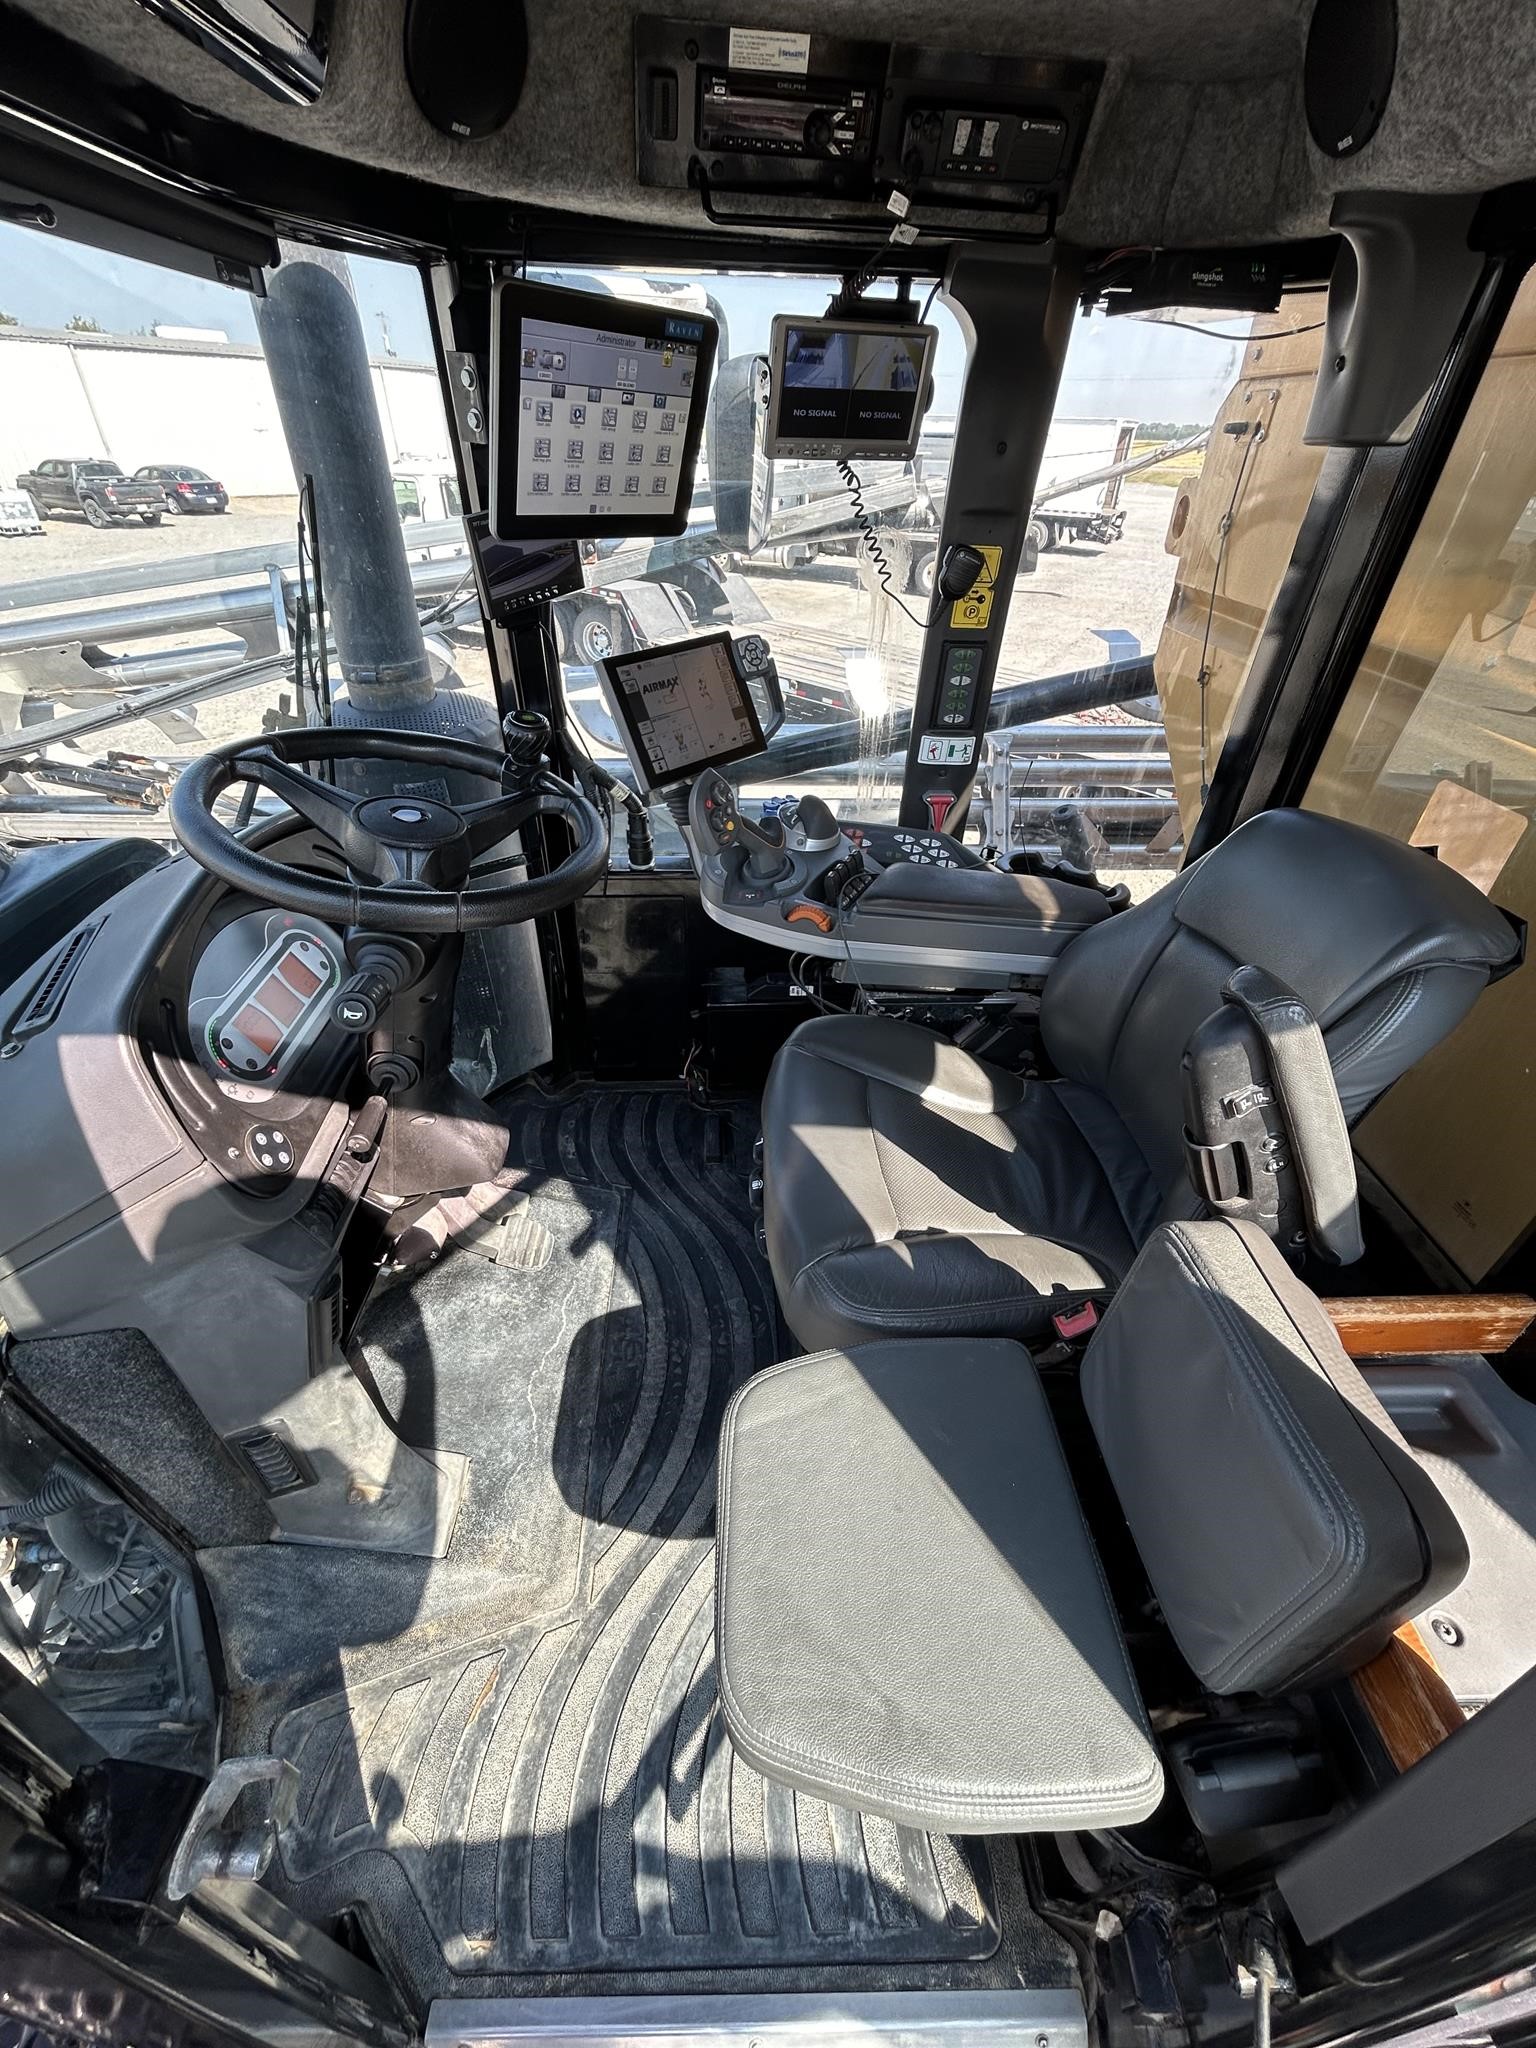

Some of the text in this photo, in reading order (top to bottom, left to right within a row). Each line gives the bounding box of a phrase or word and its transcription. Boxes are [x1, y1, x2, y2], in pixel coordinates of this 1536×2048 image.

[1192, 271, 1224, 283] slingshot
[669, 321, 700, 337] RAVEN
[596, 333, 637, 348] Administrator
[793, 409, 837, 417] NO SIGNAL
[859, 411, 901, 419] NO SIGNAL
[642, 676, 679, 695] AIRMAX
